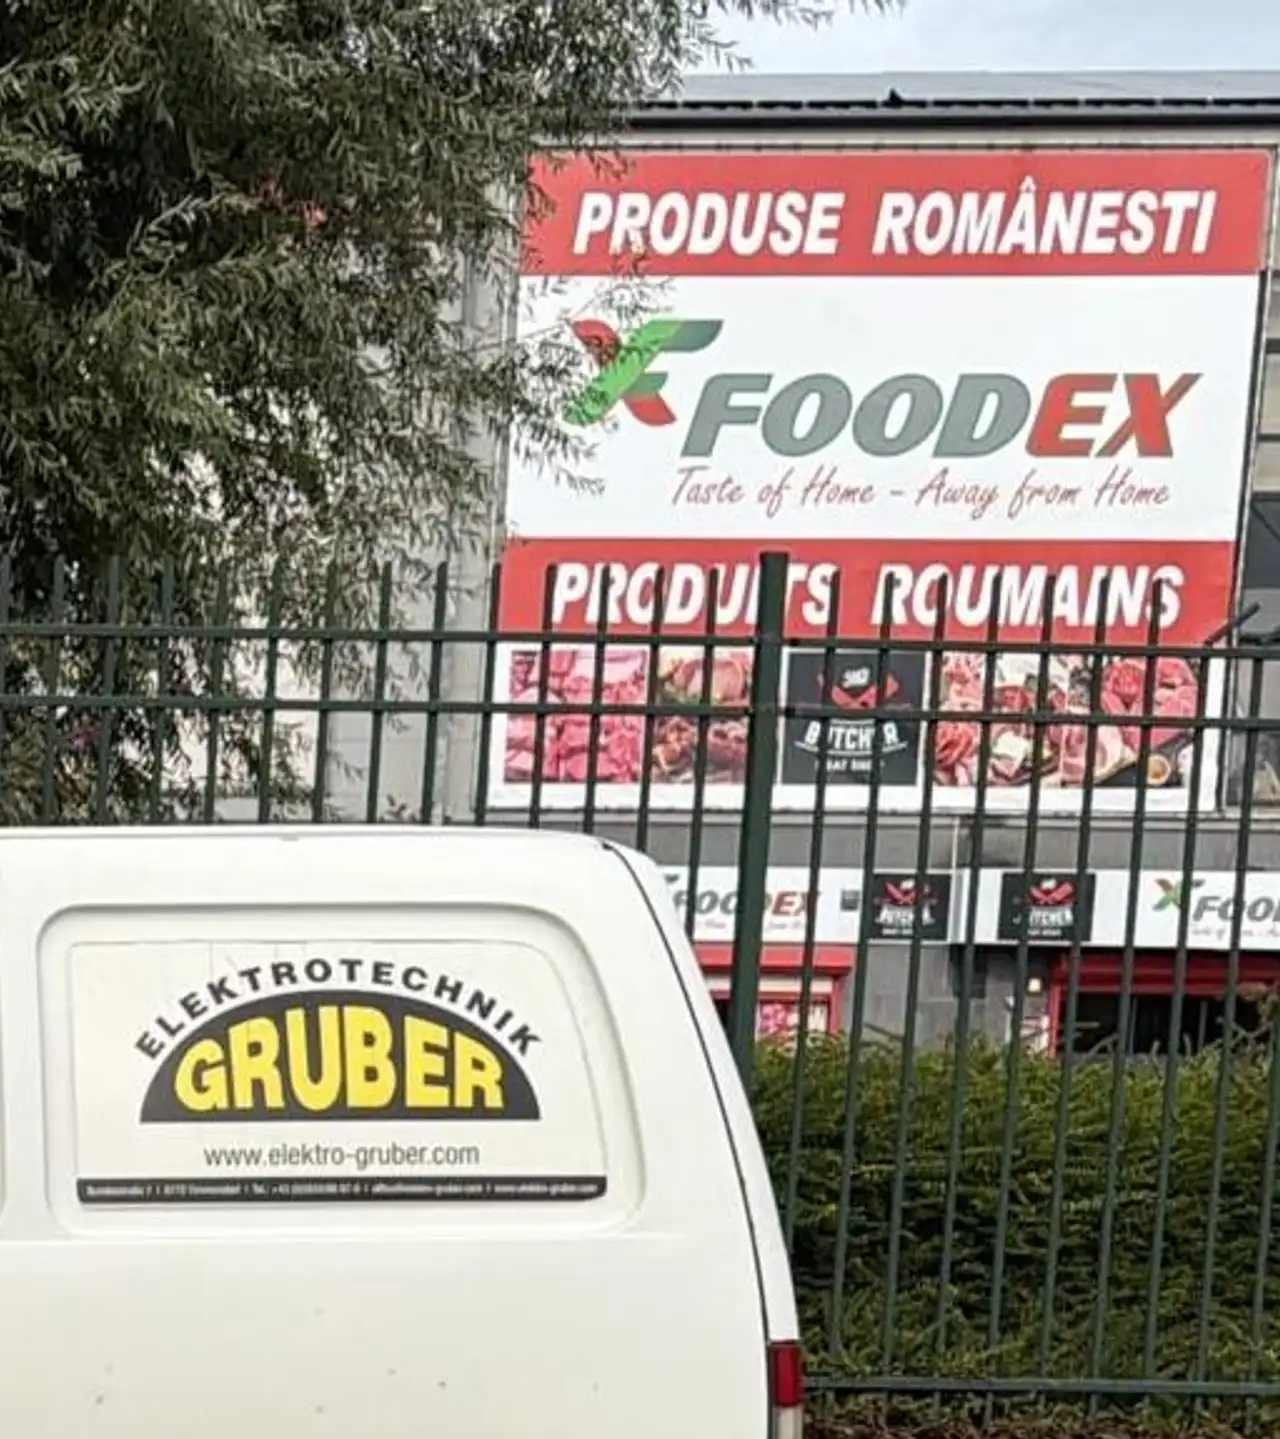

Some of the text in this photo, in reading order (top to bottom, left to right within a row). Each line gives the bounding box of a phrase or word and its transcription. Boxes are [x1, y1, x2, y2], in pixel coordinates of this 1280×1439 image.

[572, 176, 1217, 256] PRODUSE ROMÂNESTI
[679, 372, 1203, 458] FOODEX
[672, 465, 745, 506] Taste
[757, 466, 793, 519] of
[800, 464, 876, 507] Home
[914, 466, 1000, 521] Away
[1006, 468, 1083, 519] from
[1094, 463, 1172, 507] Home
[870, 562, 1185, 628] ROUMAINS
[135, 958, 541, 1060] ELEKTROTECHNIK
[173, 1004, 505, 1113] GRUBER
[203, 1142, 481, 1171] www.elektro-gruber.com
